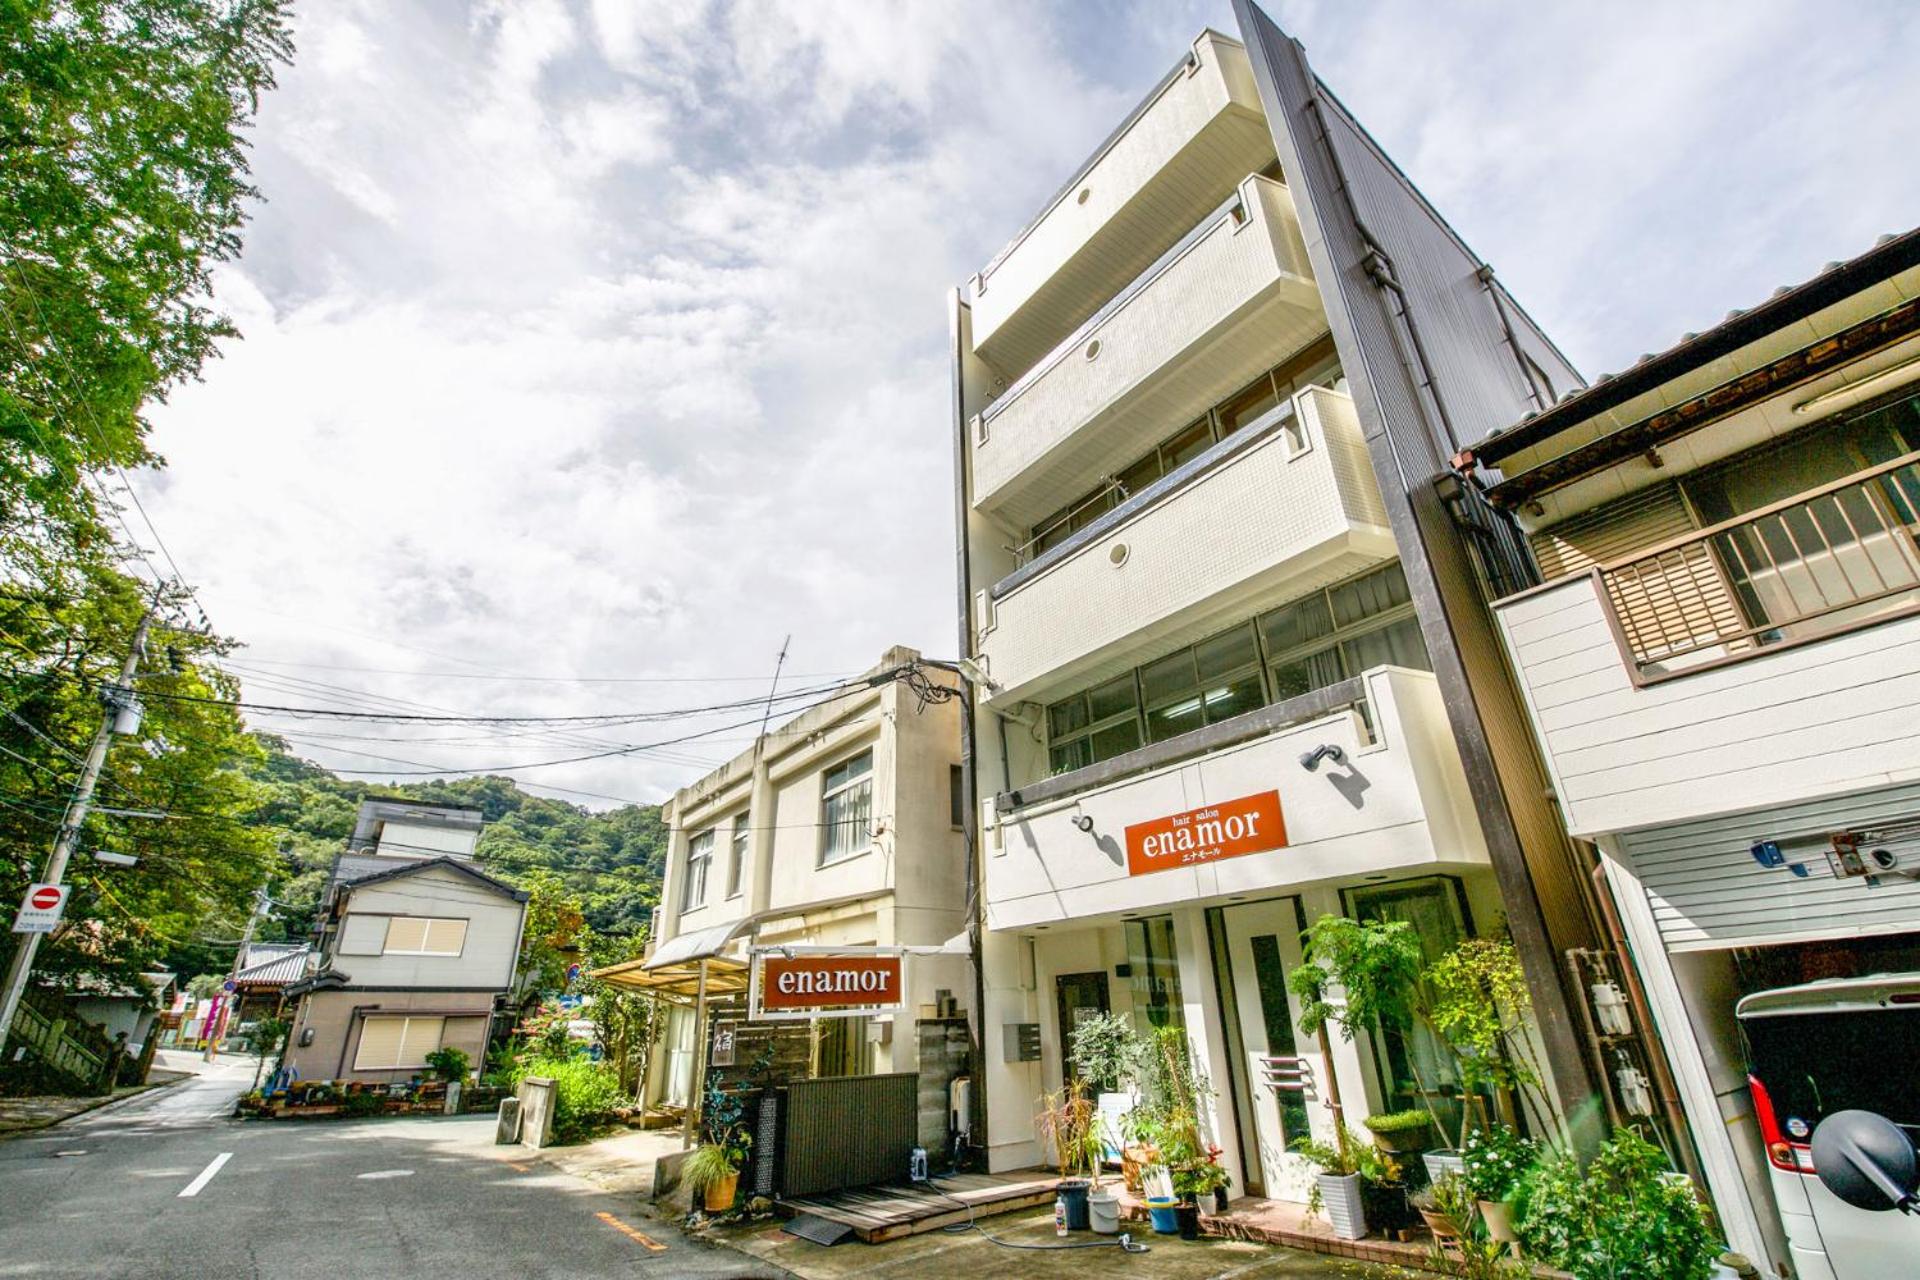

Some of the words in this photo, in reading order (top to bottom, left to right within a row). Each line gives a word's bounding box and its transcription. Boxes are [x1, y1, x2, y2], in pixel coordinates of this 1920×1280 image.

[1172, 816, 1191, 827] hair
[1196, 809, 1219, 821] salon
[1142, 811, 1261, 858] enamor
[777, 969, 892, 994] enamor
